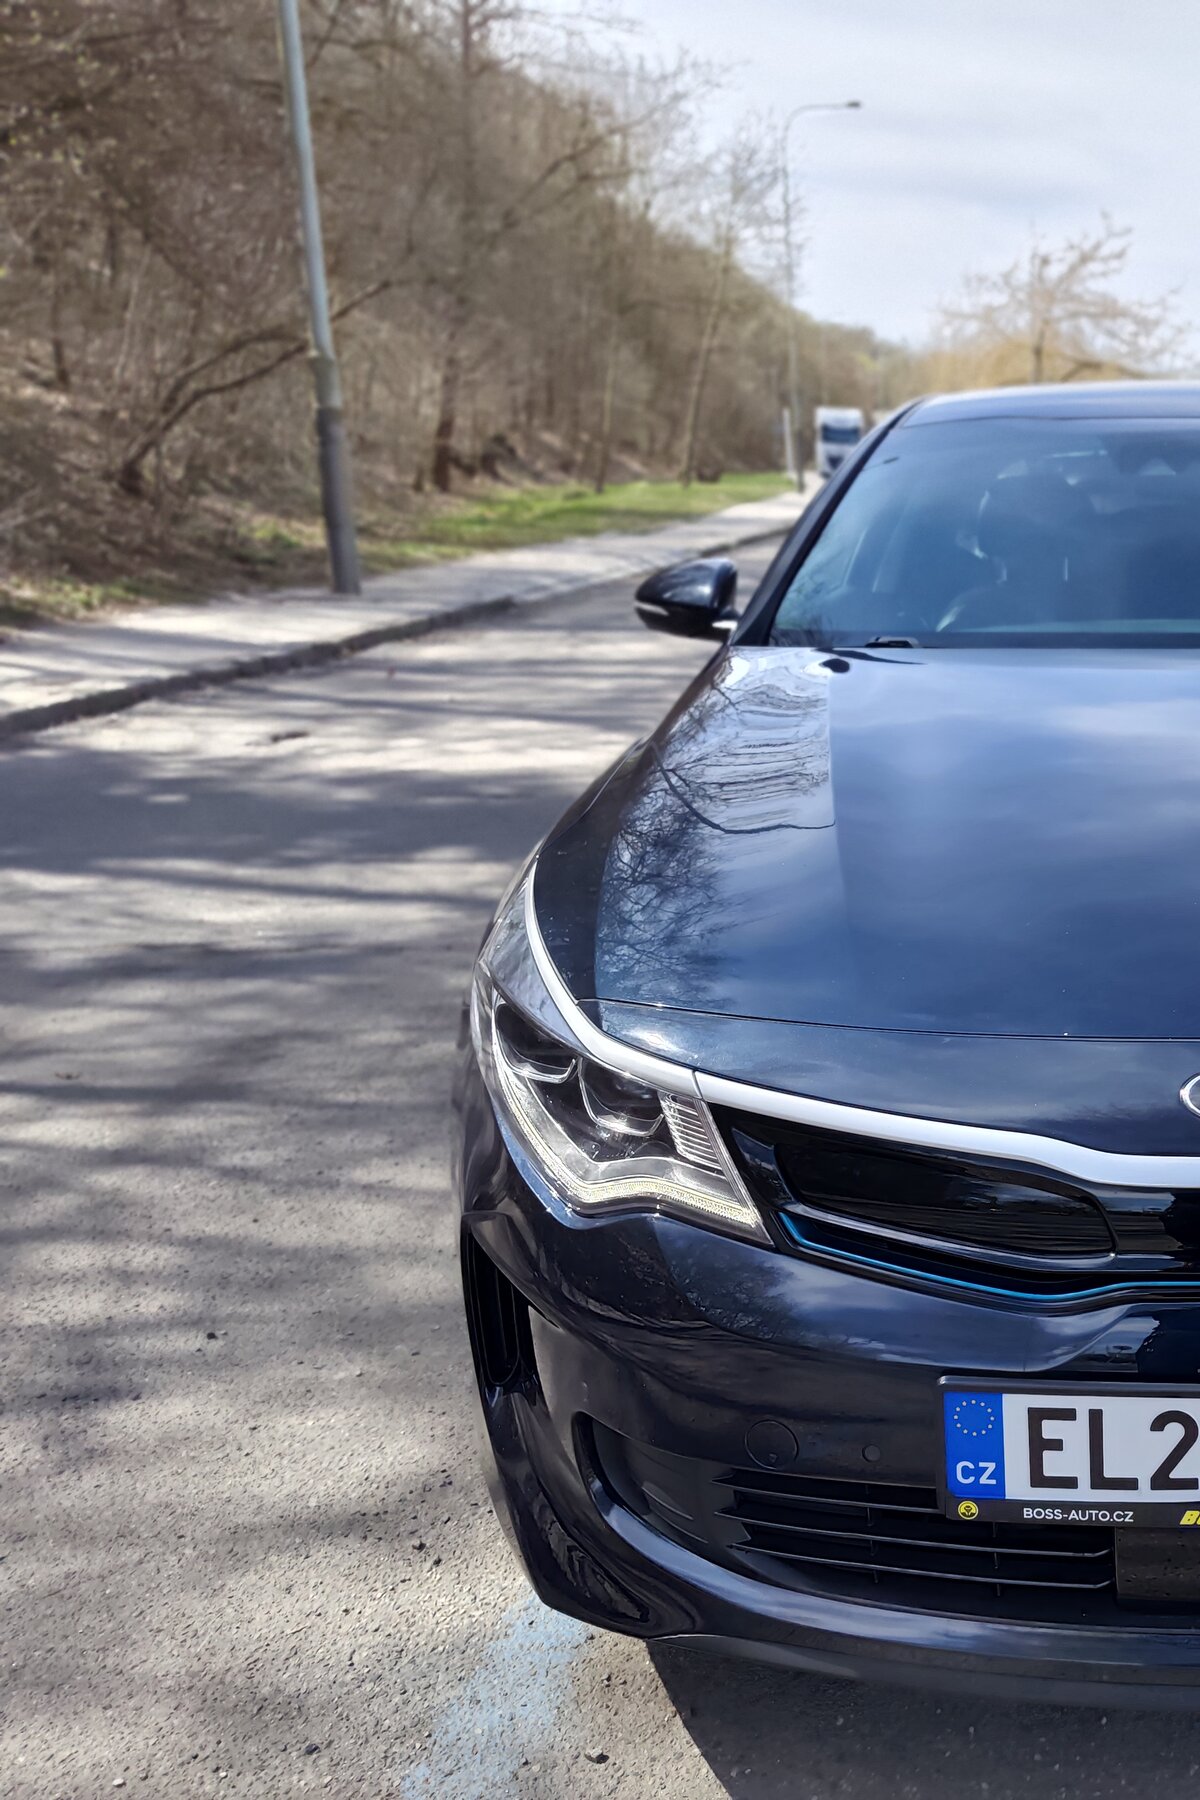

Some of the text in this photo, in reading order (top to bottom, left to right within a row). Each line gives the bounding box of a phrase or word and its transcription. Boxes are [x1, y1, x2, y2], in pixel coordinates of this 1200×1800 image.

[1027, 1406, 1199, 1490] EL2
[956, 1461, 997, 1485] CZ
[1023, 1507, 1134, 1523] BOSS-AUTO.CZ
